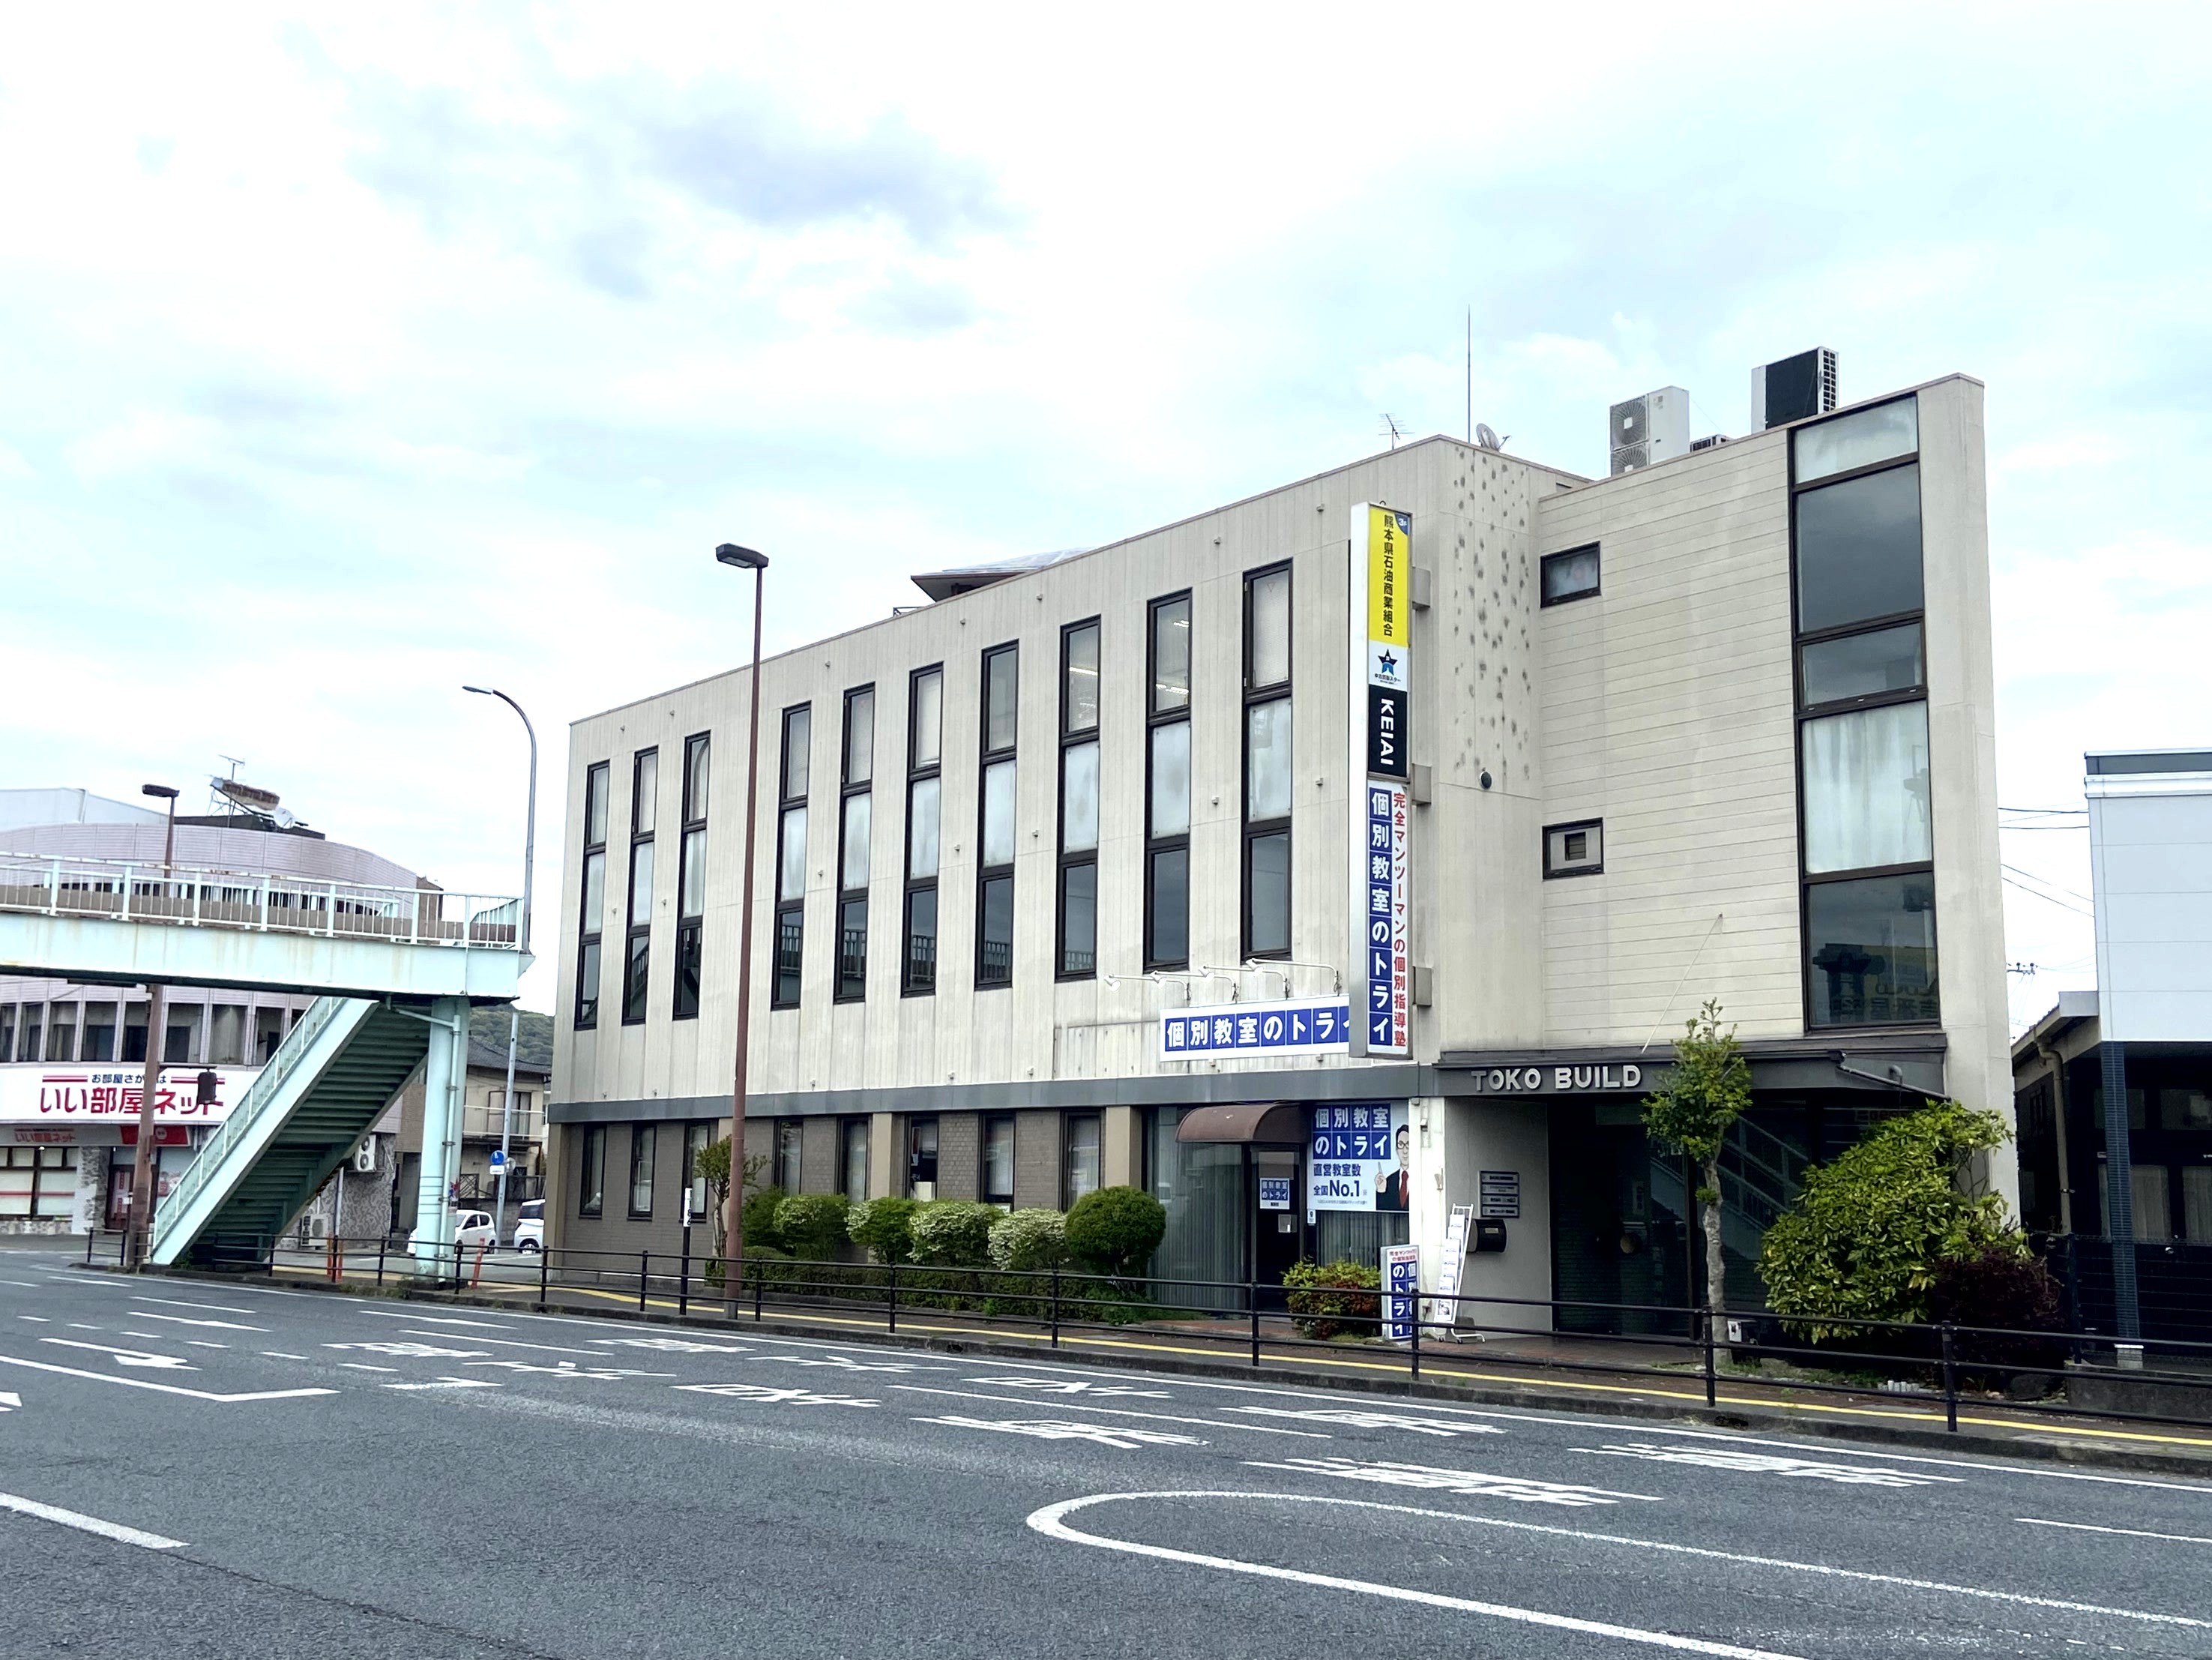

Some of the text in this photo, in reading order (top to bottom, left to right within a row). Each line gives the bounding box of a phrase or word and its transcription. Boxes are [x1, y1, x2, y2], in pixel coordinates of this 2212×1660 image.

[1383, 514, 1393, 637] 熊本県石油商業組合
[1380, 698, 1394, 766] KEIAI
[1371, 791, 1390, 1042] 個別教室のトライ
[1393, 792, 1406, 1047] 完全マンツーマンの個別指導塾
[1167, 1011, 1350, 1047] 個別教室のトラ
[91, 1073, 166, 1084] お部屋さがは
[1471, 1065, 1642, 1092] TOKO BUILD
[1315, 1107, 1389, 1128] 個別教室
[1315, 1134, 1388, 1156] のトライ
[1313, 1163, 1361, 1177] 直営教室数
